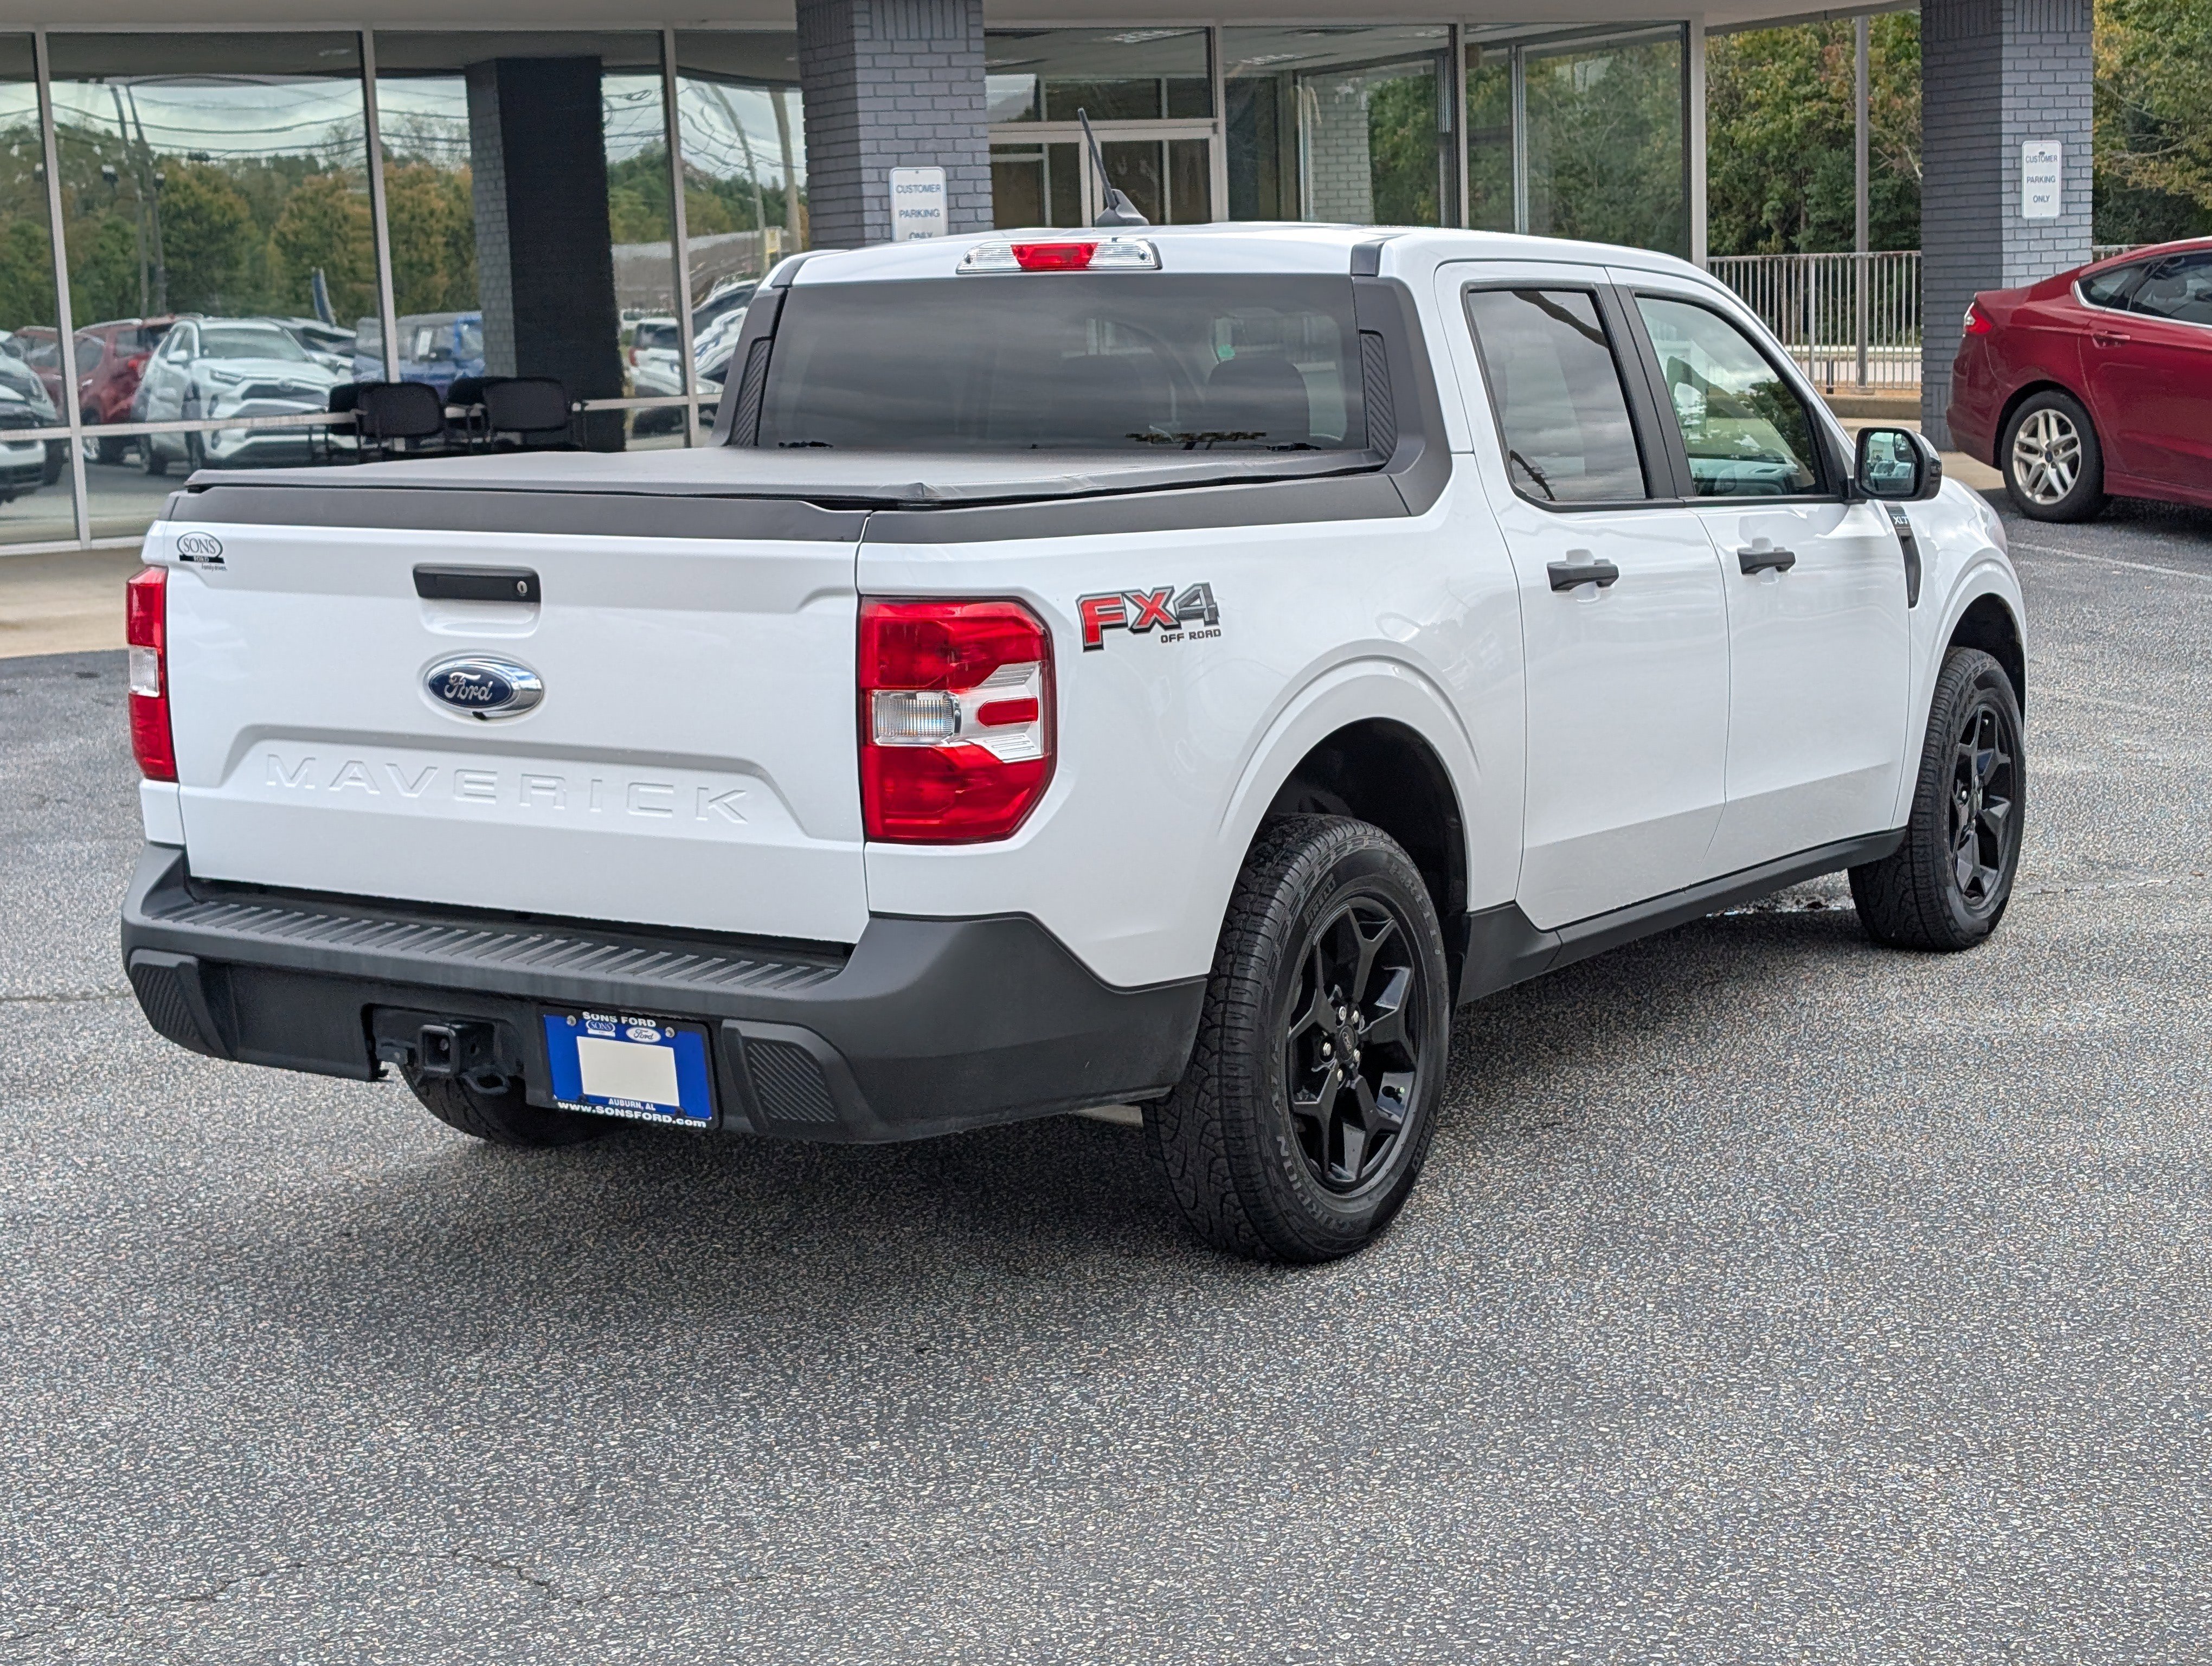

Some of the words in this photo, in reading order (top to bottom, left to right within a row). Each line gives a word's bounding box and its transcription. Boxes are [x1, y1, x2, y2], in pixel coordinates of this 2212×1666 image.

[2025, 155, 2058, 163] CUSTOMER
[2027, 175, 2056, 183] PARKING
[896, 184, 941, 193] CUSTOMER
[2033, 195, 2050, 203] ONLY
[898, 209, 941, 217] PARKING
[1892, 516, 1908, 525] XLT
[183, 537, 216, 554] SONS
[1075, 581, 1220, 652] FX4
[1160, 632, 1185, 644] OFF
[1188, 629, 1221, 640] ROAD
[443, 671, 494, 701] Ford
[265, 753, 749, 825] MAVERICK
[582, 1011, 618, 1023] SONS
[621, 1016, 656, 1027] FORD
[590, 1021, 612, 1031] SONS
[633, 1028, 654, 1040] Ford
[608, 1098, 644, 1110] AUBURN,
[557, 1101, 707, 1127] www.SONSFORD.com
